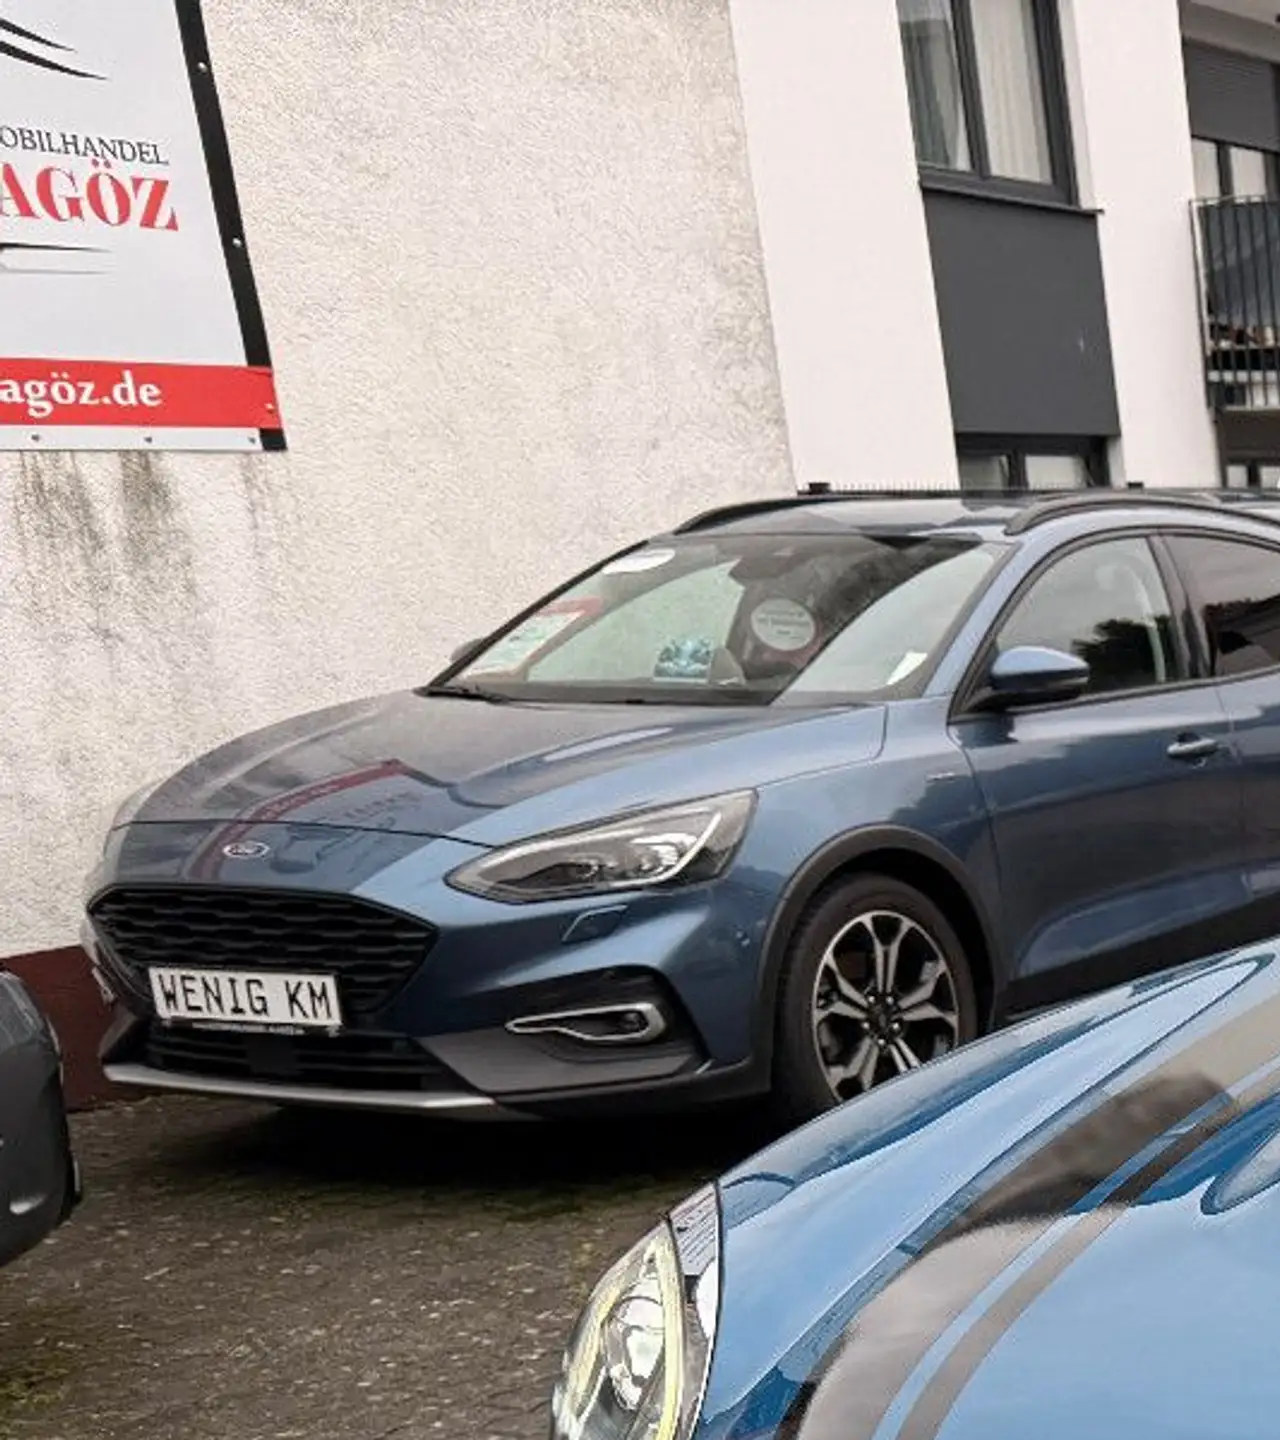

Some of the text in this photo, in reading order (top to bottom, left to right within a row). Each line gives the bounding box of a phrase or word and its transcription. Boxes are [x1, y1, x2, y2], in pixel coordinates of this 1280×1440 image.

[0, 369, 163, 418] agöz.de
[157, 973, 333, 1019] WENIG KM
